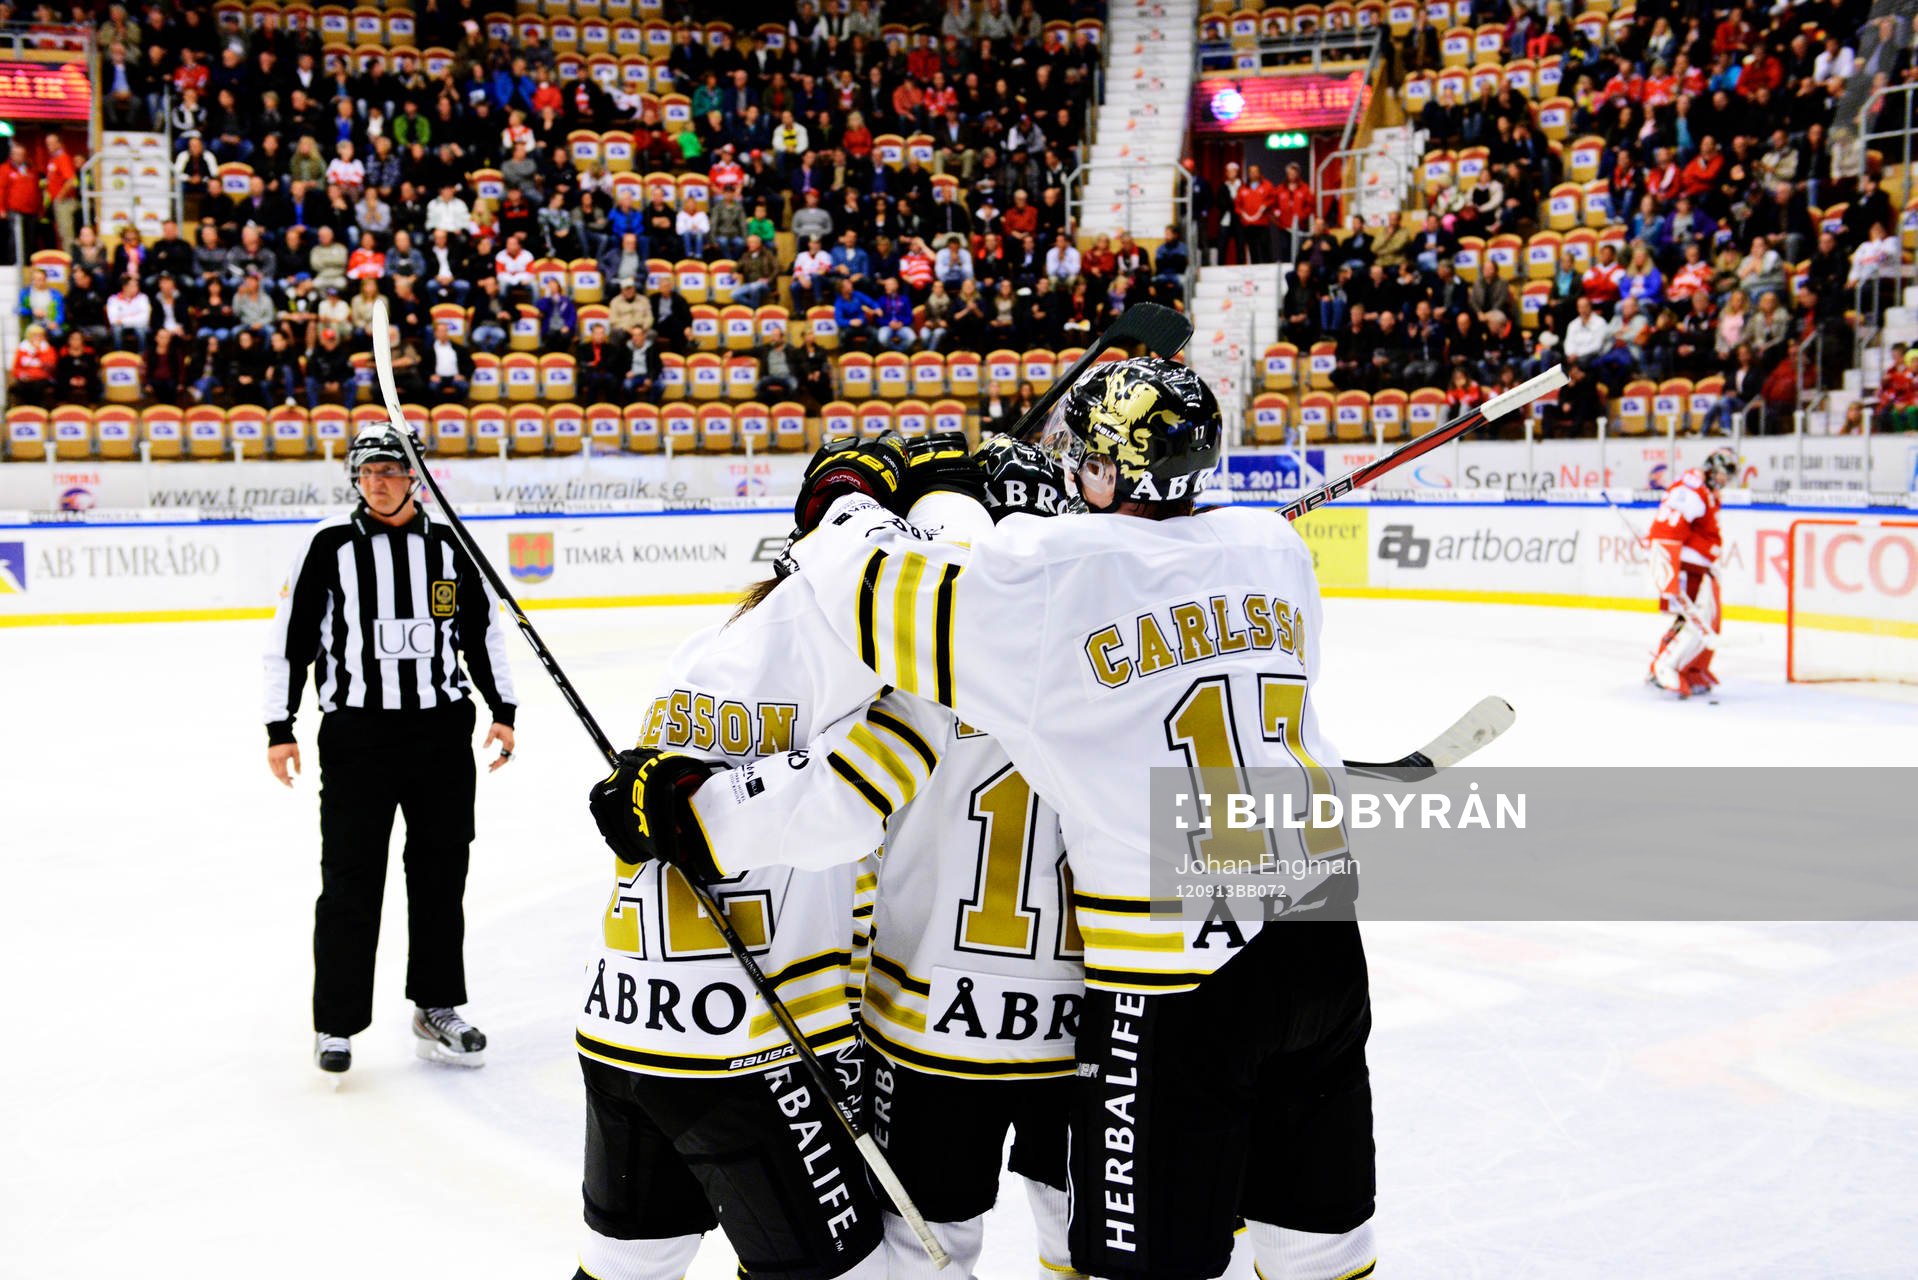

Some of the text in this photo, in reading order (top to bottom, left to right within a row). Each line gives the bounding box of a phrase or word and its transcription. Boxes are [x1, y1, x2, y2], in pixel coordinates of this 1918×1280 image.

[1193, 425, 1205, 440] 17
[1026, 451, 1037, 461] 12
[1343, 454, 1377, 466] TIMR
[1130, 470, 1219, 501] ÅBR
[1250, 470, 1298, 489] 2014
[1465, 464, 1614, 490] ServaNet
[149, 483, 356, 507] www.tmraik.se
[1292, 521, 1361, 539] torer
[36, 534, 220, 579] AB TIMRÅBO
[564, 543, 727, 565] TIMRÅ KOMMUN
[1435, 530, 1579, 564] artboard
[379, 622, 432, 654] UC
[1084, 594, 1306, 689] CARLSSO
[636, 689, 799, 757] ESSON
[1164, 673, 1350, 876] 17
[584, 958, 747, 1035] ÅBRO
[933, 977, 1082, 1040] ÅBR
[729, 1046, 797, 1070] BAUER
[1104, 992, 1145, 1252] HERBALIFE
[764, 1066, 858, 1239] RBALIFE
